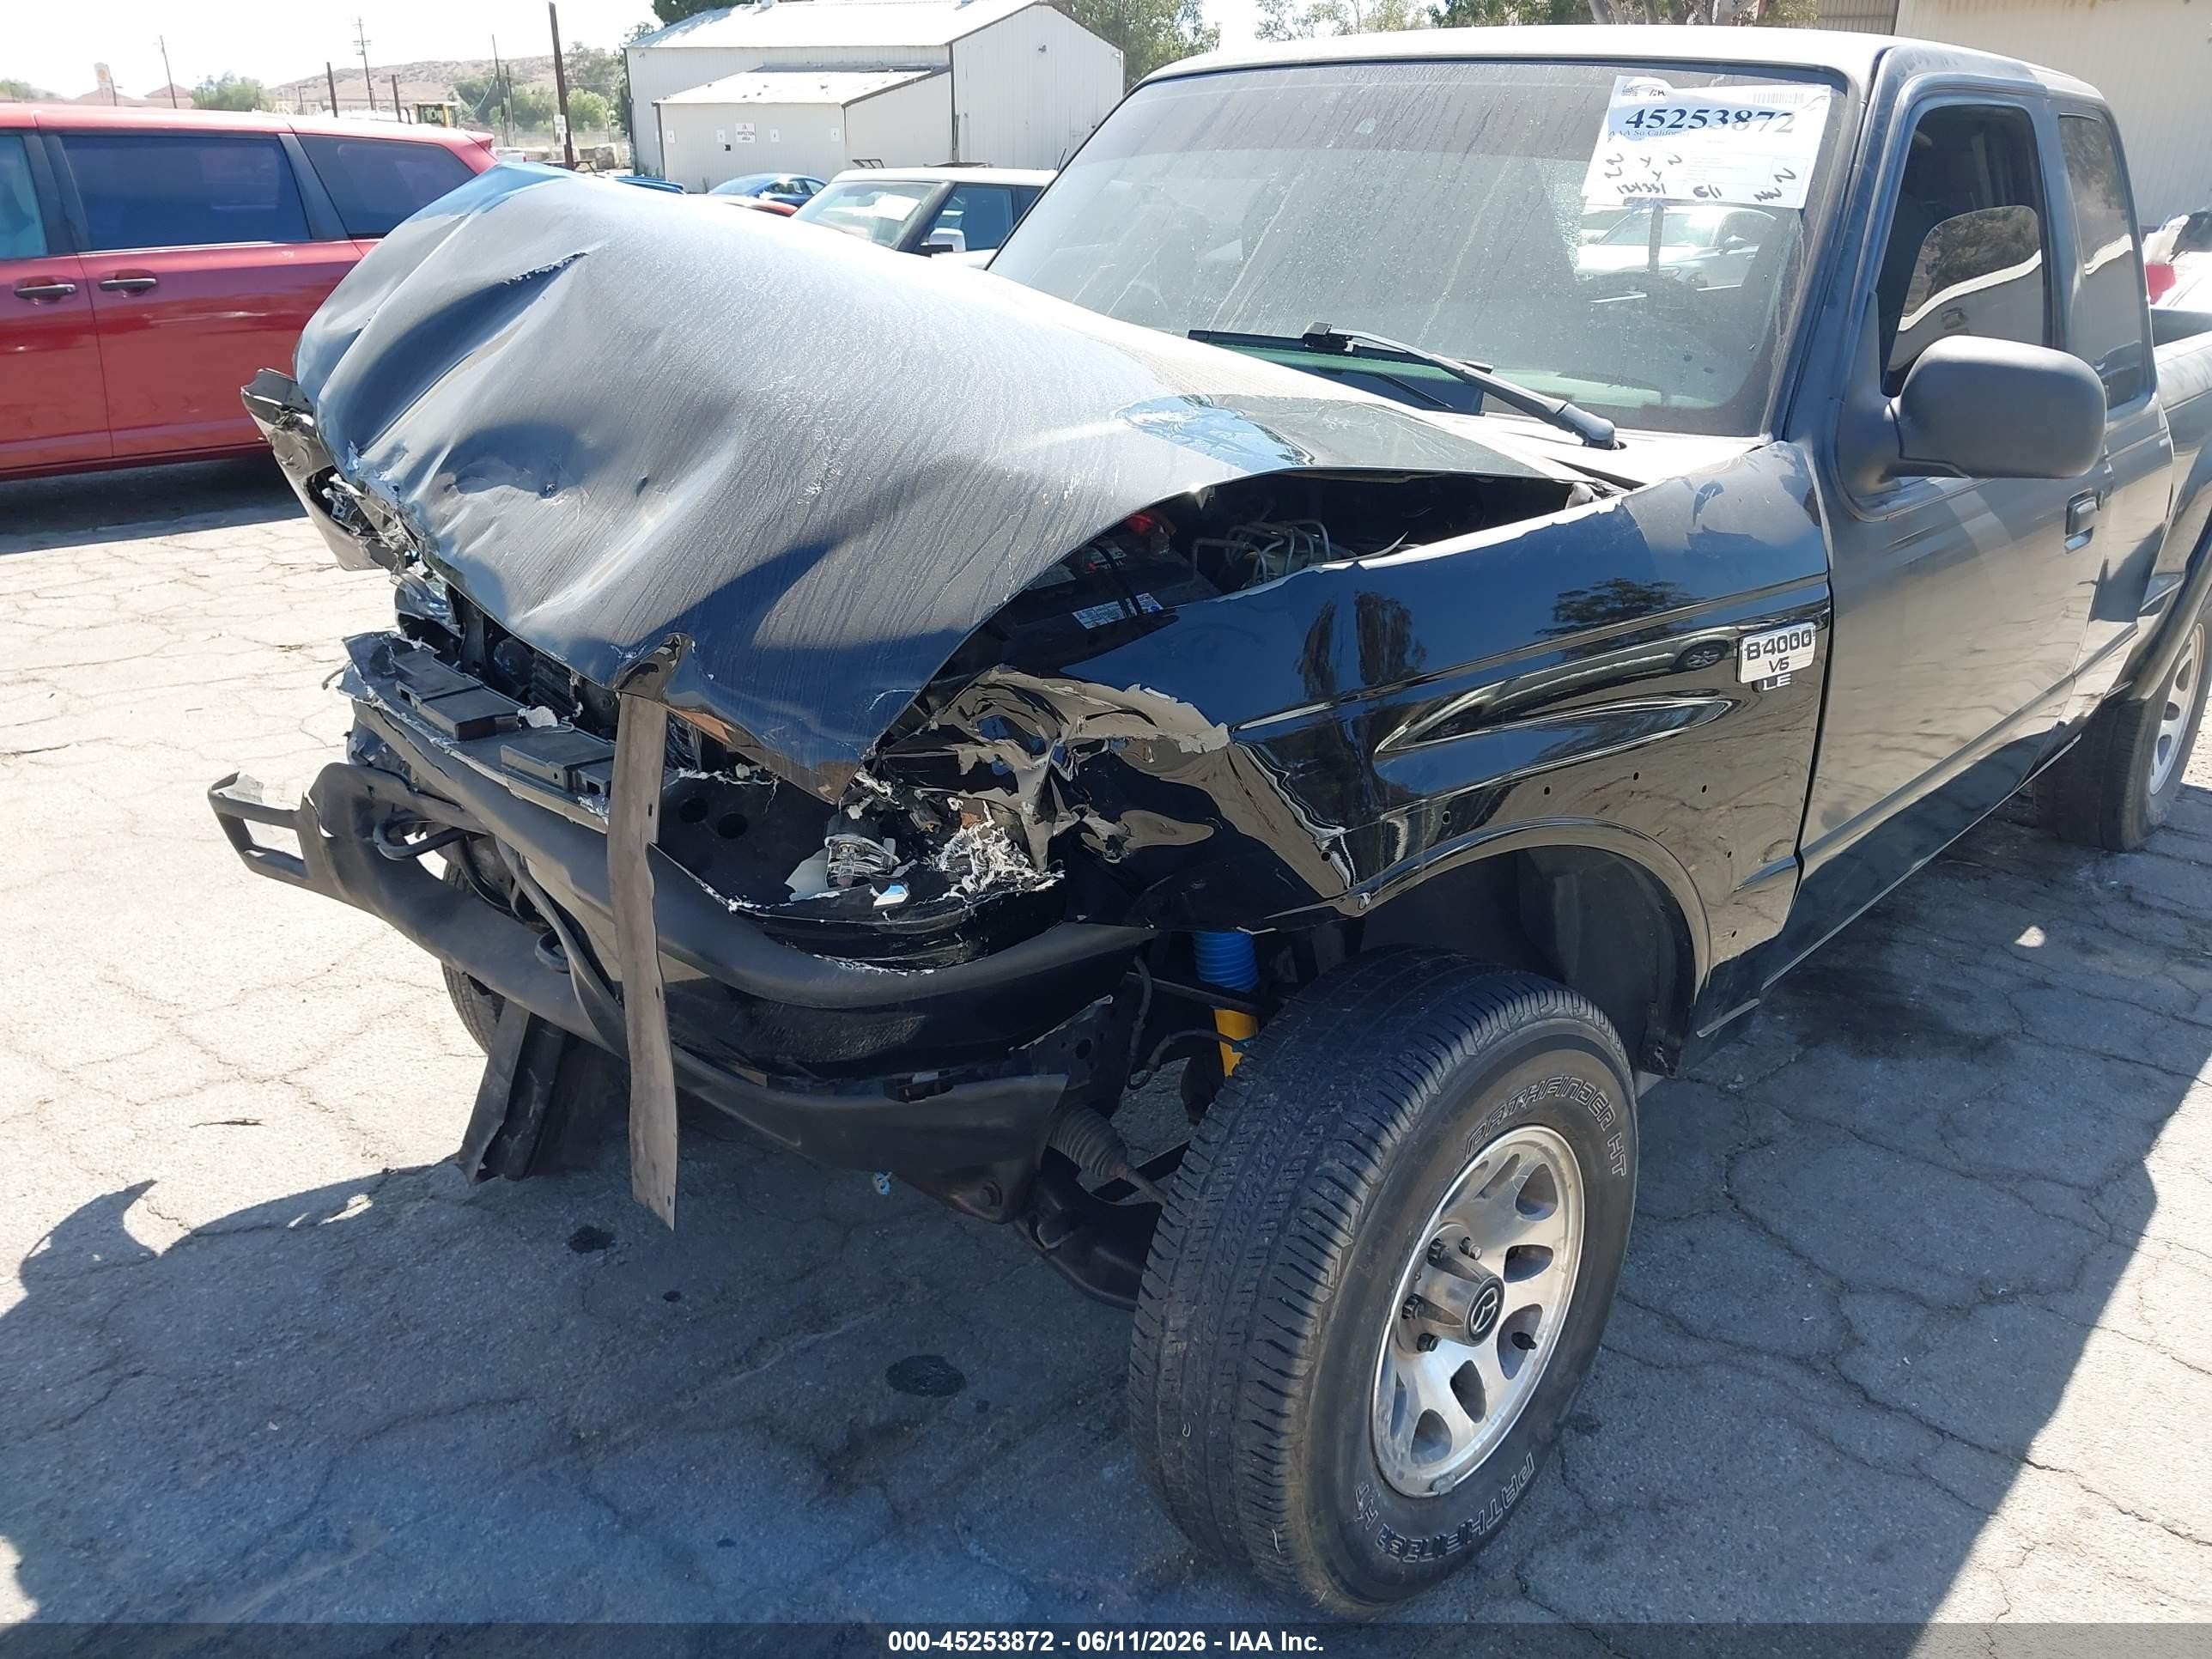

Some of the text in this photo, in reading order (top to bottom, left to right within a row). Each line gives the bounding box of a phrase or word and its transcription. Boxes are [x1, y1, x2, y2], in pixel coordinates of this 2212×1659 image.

[1626, 107, 1795, 133] 45253872
[1747, 629, 1812, 660] B4000
[1769, 656, 1790, 672] V6
[1762, 673, 1791, 690] LE
[1465, 1074, 1627, 1177] PATHFINDER HT
